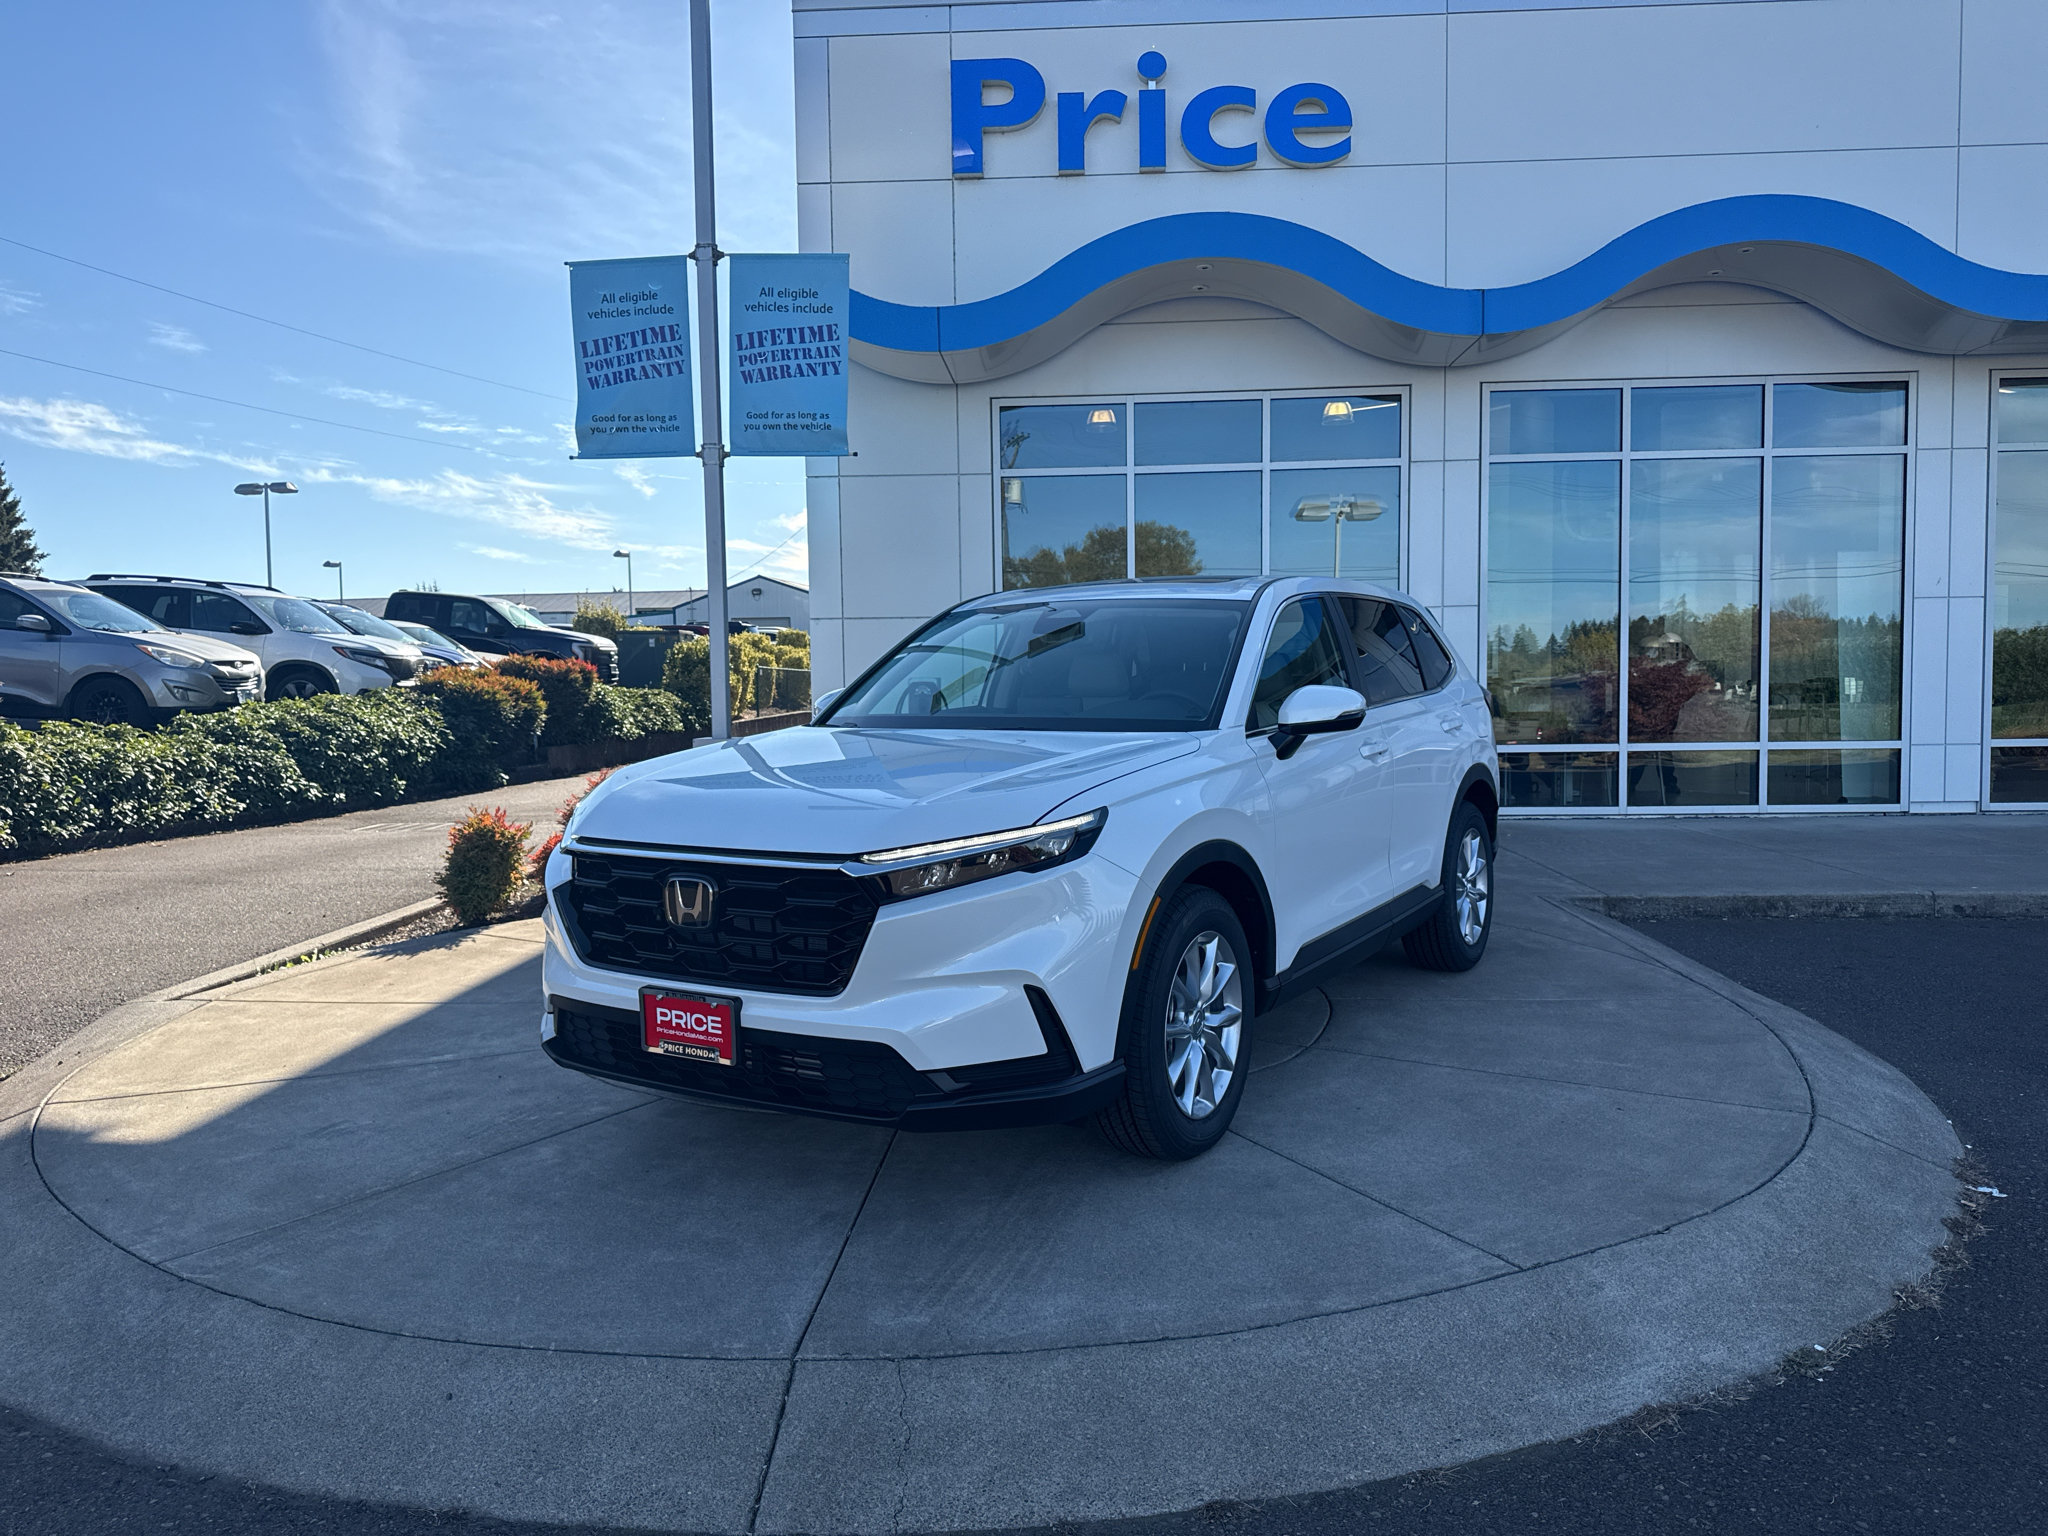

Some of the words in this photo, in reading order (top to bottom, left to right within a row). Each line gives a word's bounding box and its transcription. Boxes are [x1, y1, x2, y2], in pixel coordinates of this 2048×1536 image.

[951, 50, 1353, 180] Price
[600, 293, 616, 305] All
[618, 290, 659, 305] eligible
[759, 287, 774, 298] All
[777, 288, 819, 301] eligible
[587, 306, 631, 320] vehicles
[633, 304, 675, 316] include
[744, 301, 790, 313] vehicles
[792, 302, 834, 314] include
[579, 323, 683, 359] LIFETIME
[735, 323, 841, 352] LIFETIME
[583, 344, 684, 374] POWERTRAIN
[738, 344, 842, 368] POWERTRAIN
[587, 360, 686, 390] WARRANTY
[740, 360, 843, 385] WARRANTY
[591, 414, 616, 423] Good
[618, 413, 632, 423] for
[646, 413, 667, 425] long
[746, 411, 769, 420] Good
[771, 411, 784, 420] for
[798, 411, 817, 422] long
[590, 426, 607, 435] you
[631, 424, 647, 433] the
[649, 424, 680, 433] vehicle
[744, 424, 761, 432] you
[762, 423, 781, 431] own
[783, 422, 799, 431] the
[800, 422, 832, 431] vehicle
[656, 1007, 722, 1035] PRICE
[663, 1043, 684, 1054] PRICE
[685, 1047, 715, 1059] HONDA
